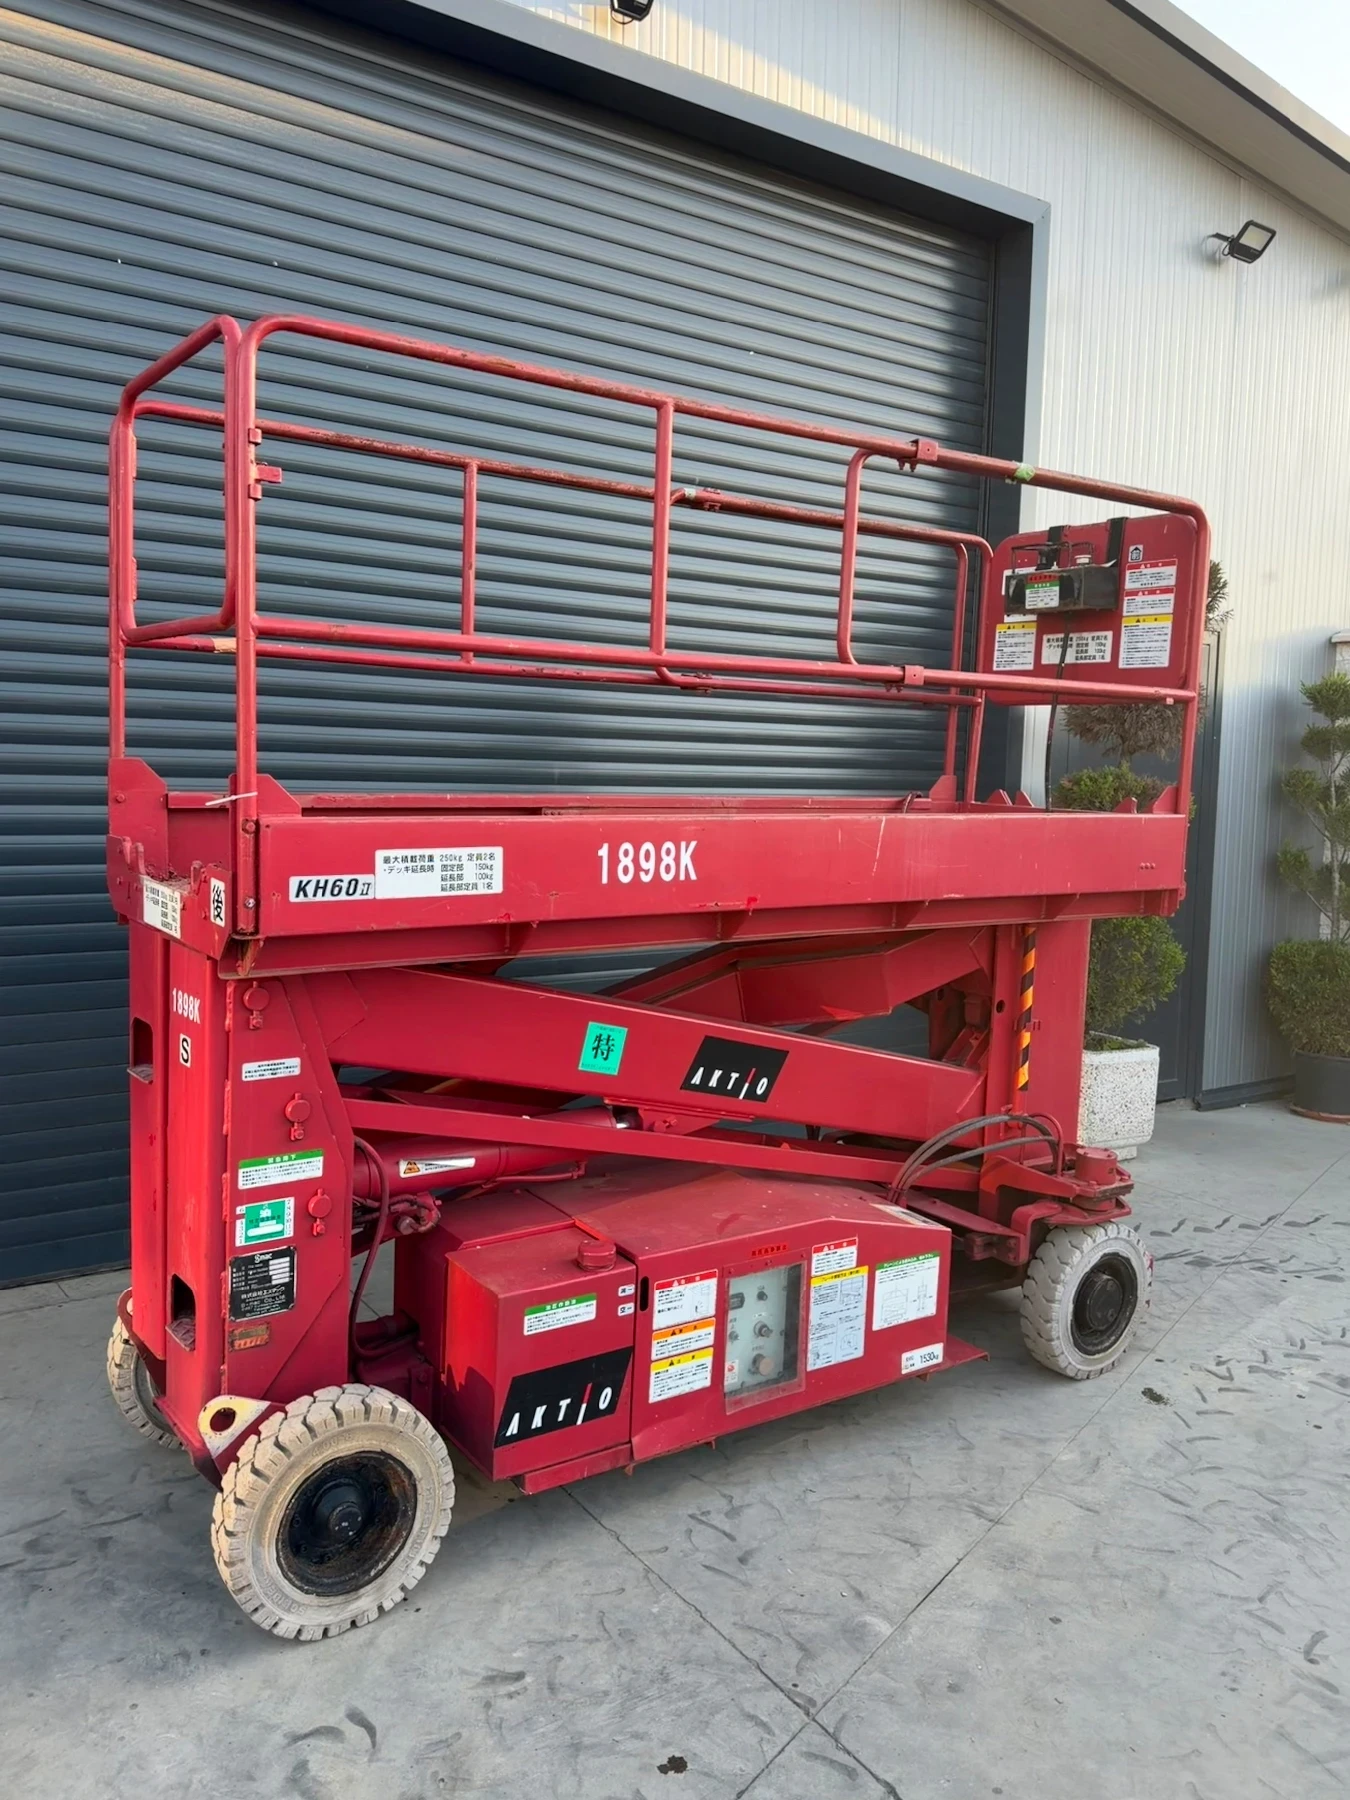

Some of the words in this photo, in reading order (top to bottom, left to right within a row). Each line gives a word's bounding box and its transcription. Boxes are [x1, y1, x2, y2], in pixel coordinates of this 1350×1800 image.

[440, 854, 462, 862] 250kg
[467, 852, 496, 862] 定員2名
[440, 864, 464, 872] 固定部
[475, 863, 493, 871] 150kg
[598, 840, 698, 884] 1898K
[440, 873, 464, 882] 延長部
[475, 873, 493, 881] 100kg
[440, 882, 478, 892] 延長部定員
[172, 988, 200, 1024] 1898K
[181, 1037, 189, 1064] S
[592, 1033, 615, 1061] 特
[691, 1068, 768, 1100] AKTIO
[505, 1383, 612, 1436] AKTIO
